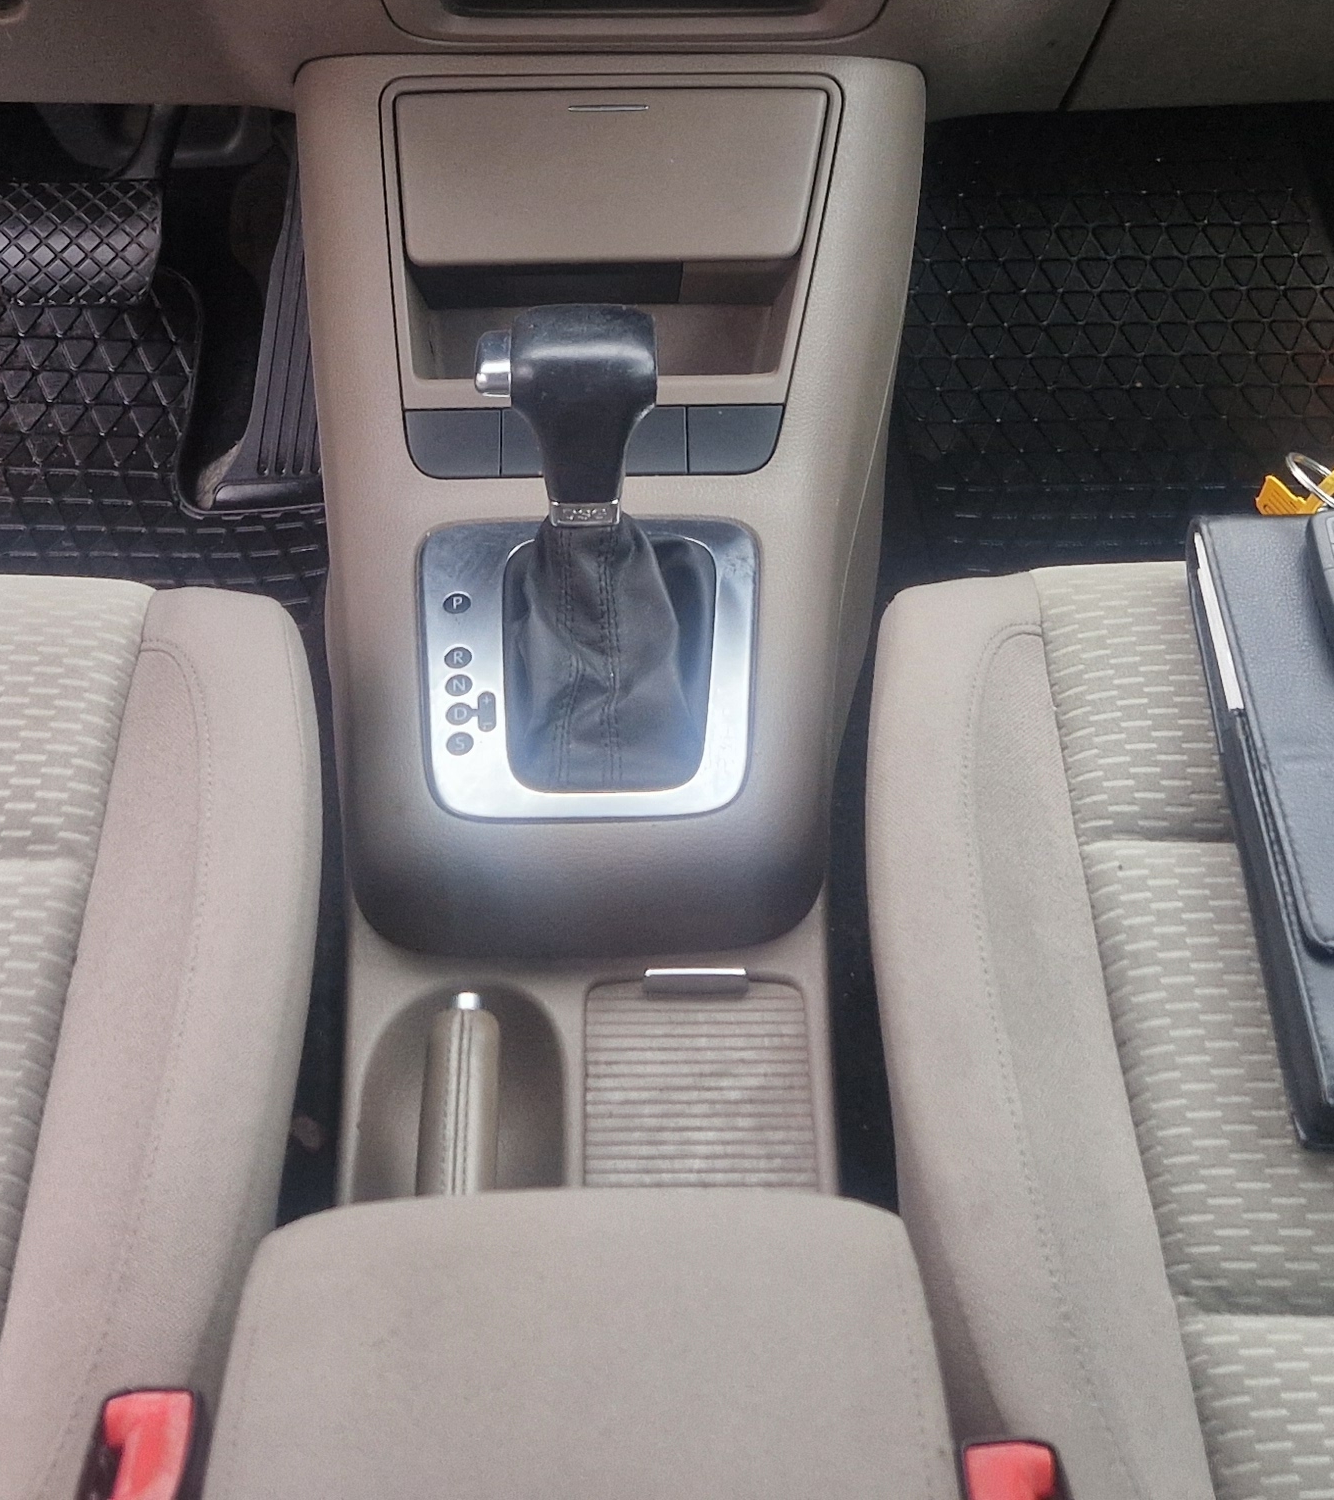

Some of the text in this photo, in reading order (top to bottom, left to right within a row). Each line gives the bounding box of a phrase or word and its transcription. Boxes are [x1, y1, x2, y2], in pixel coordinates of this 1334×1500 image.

[452, 596, 463, 610] P
[453, 651, 464, 664] R
[452, 678, 466, 691] N
[454, 707, 467, 721] D
[455, 737, 466, 751] S
